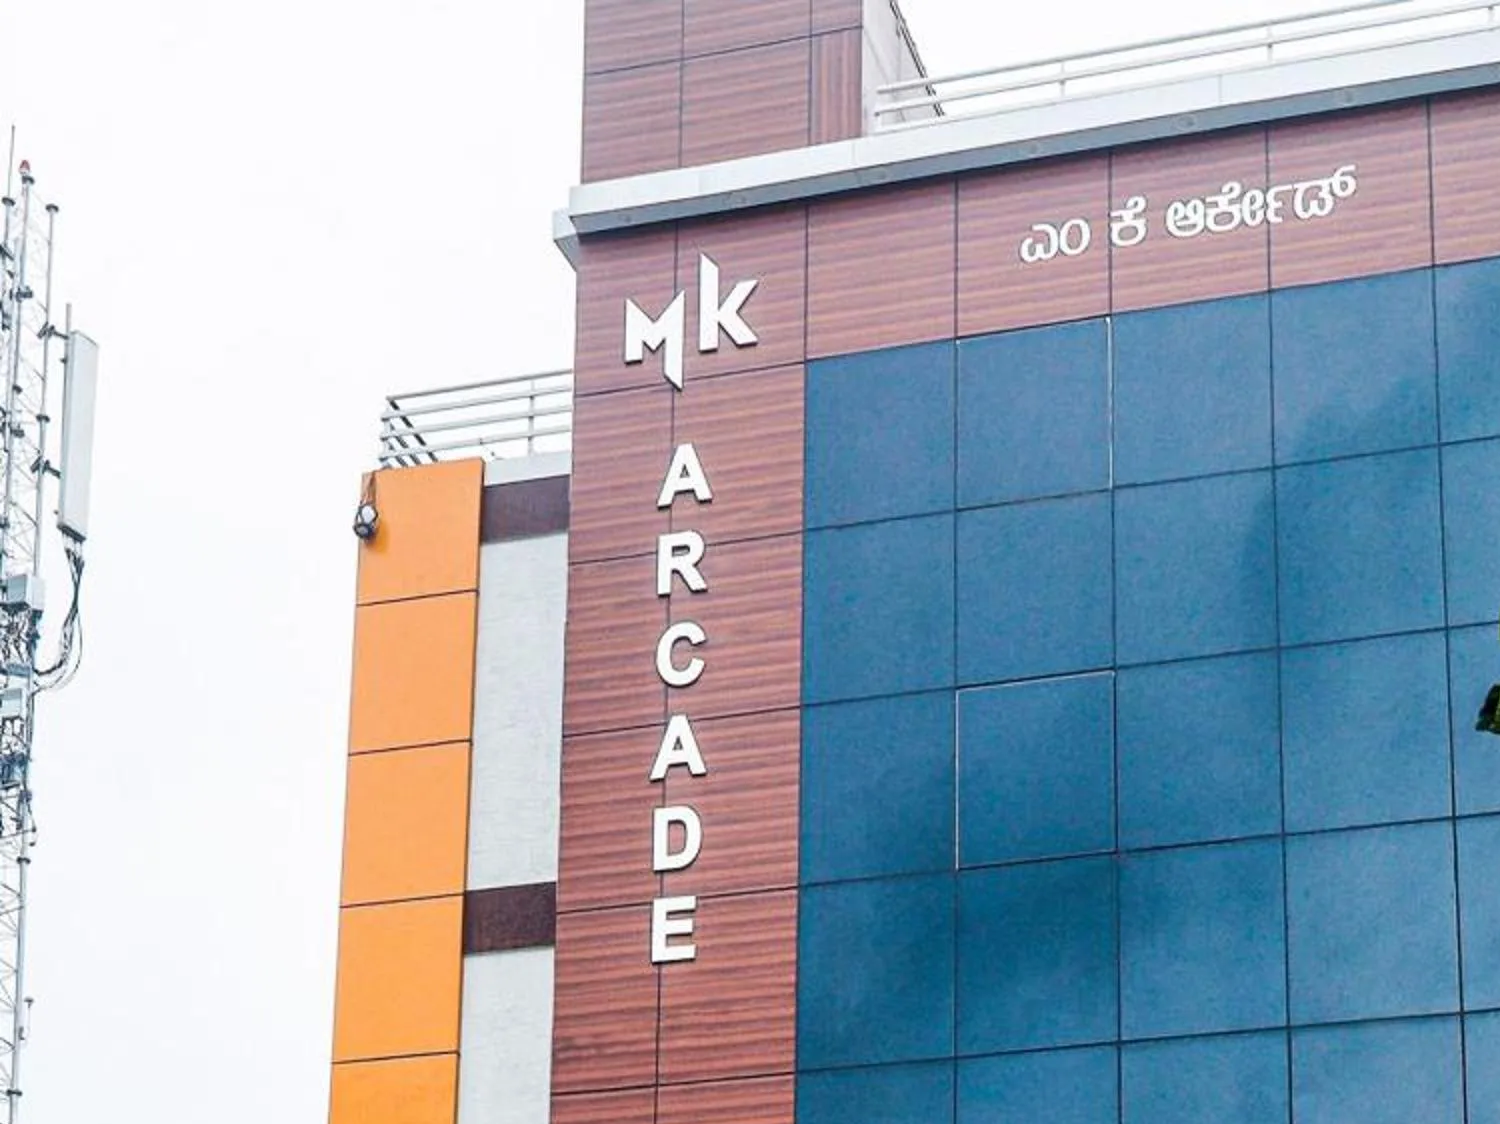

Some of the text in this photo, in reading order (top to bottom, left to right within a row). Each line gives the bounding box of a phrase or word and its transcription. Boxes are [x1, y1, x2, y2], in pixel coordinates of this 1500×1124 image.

[1019, 217, 1091, 263] ಎಂ
[1110, 196, 1147, 247] ಕೆ
[650, 443, 714, 963] ARCADE
